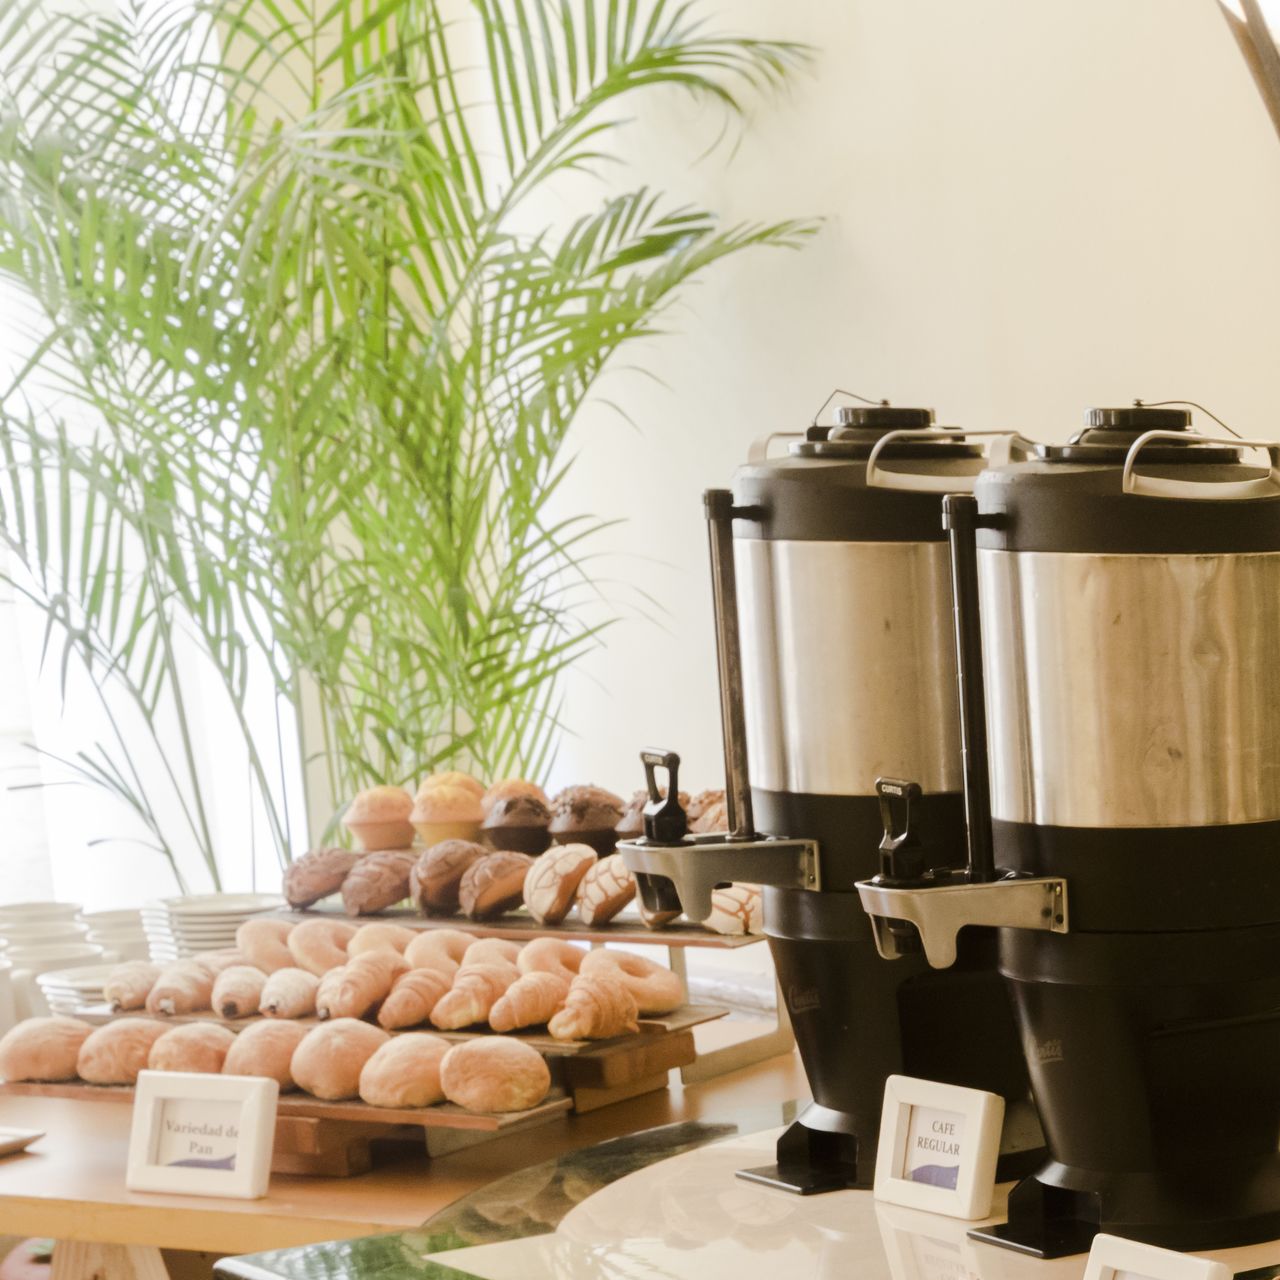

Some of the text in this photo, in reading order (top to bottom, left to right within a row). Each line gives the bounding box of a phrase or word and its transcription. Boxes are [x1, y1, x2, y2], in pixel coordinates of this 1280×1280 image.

[166, 1120, 239, 1138] Variedad de
[931, 1120, 956, 1136] CAFE
[188, 1141, 213, 1154] Pan
[917, 1136, 960, 1156] REGULAR
